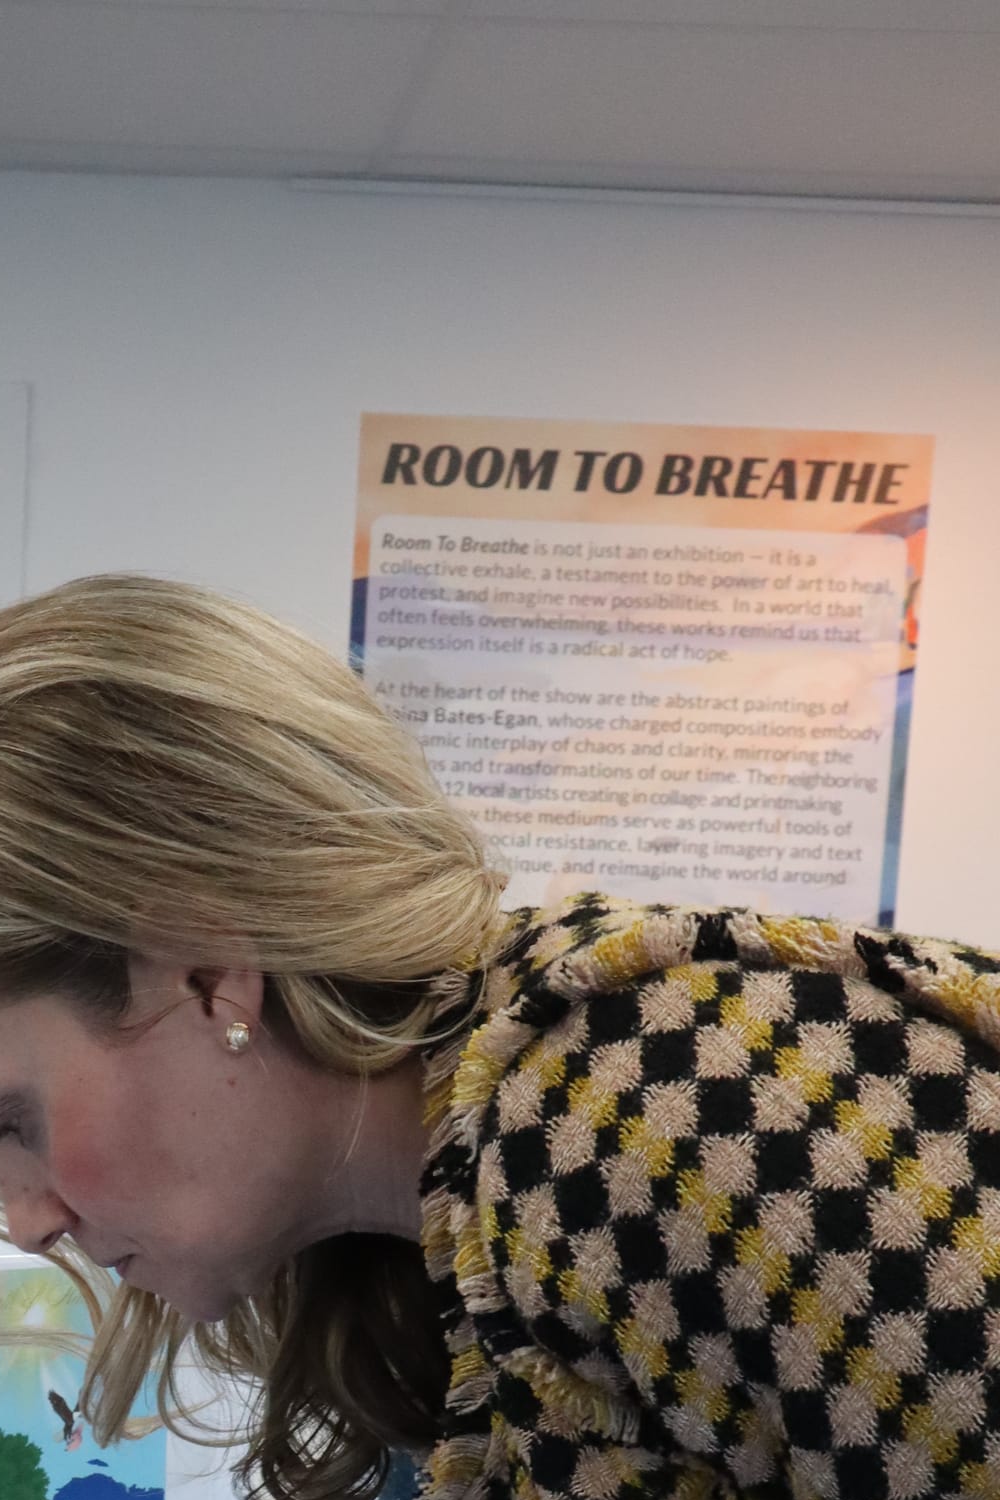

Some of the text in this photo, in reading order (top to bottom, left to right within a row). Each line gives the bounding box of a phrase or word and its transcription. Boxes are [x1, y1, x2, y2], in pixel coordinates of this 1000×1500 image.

[380, 442, 909, 506] ROOM TO BREATHE
[382, 533, 744, 563] Room To Breathe not just an exhibition
[380, 559, 467, 576] collective
[556, 565, 648, 583] testament
[655, 569, 672, 584] to
[678, 570, 705, 585] the
[711, 575, 767, 590] power
[773, 574, 792, 589] of
[796, 575, 822, 590] art
[828, 576, 846, 591] to
[455, 587, 488, 602] and
[494, 588, 563, 608] imagine
[569, 595, 605, 606] new
[611, 594, 720, 611] possibilities.
[733, 597, 750, 612] In
[770, 600, 820, 615] world
[827, 601, 862, 617] that
[378, 608, 425, 624] often
[431, 610, 474, 626] feels
[617, 618, 665, 633] these
[670, 621, 724, 636] works
[730, 624, 794, 639] remind
[824, 626, 861, 641] that
[376, 635, 732, 664] expression itself radical act of hope.
[375, 681, 825, 716] At the heart of the show are the abstract paintings
[547, 713, 604, 729] whose
[609, 715, 681, 735] charged
[686, 721, 806, 738] compositions
[811, 724, 881, 744] embody
[466, 734, 545, 755] interplay
[574, 739, 625, 754] chaos
[632, 741, 662, 755] and
[668, 742, 727, 762] clarity,
[733, 745, 818, 766] mirroring
[825, 748, 852, 763] the
[451, 758, 483, 772] and
[489, 759, 632, 779] transformations
[660, 770, 690, 781] our
[696, 767, 739, 783] time.
[747, 769, 778, 784] The
[779, 771, 877, 793] neighboring
[468, 782, 504, 797] local
[508, 784, 558, 799] artists
[562, 787, 628, 806] creating
[711, 792, 740, 806] and
[744, 794, 842, 814] printmaking
[484, 807, 533, 823] these
[538, 810, 618, 826] mediums
[622, 816, 670, 828] serve
[700, 817, 780, 834] powerful
[785, 818, 827, 834] tools
[833, 821, 851, 835] of
[489, 832, 530, 847] ocial
[637, 837, 708, 859] layering
[713, 840, 784, 862] imagery
[789, 844, 822, 859] and
[828, 845, 862, 861] text
[562, 859, 594, 873] and
[600, 860, 687, 880] reimagine
[693, 863, 722, 878] the
[727, 866, 778, 881] world
[782, 869, 846, 883] around
